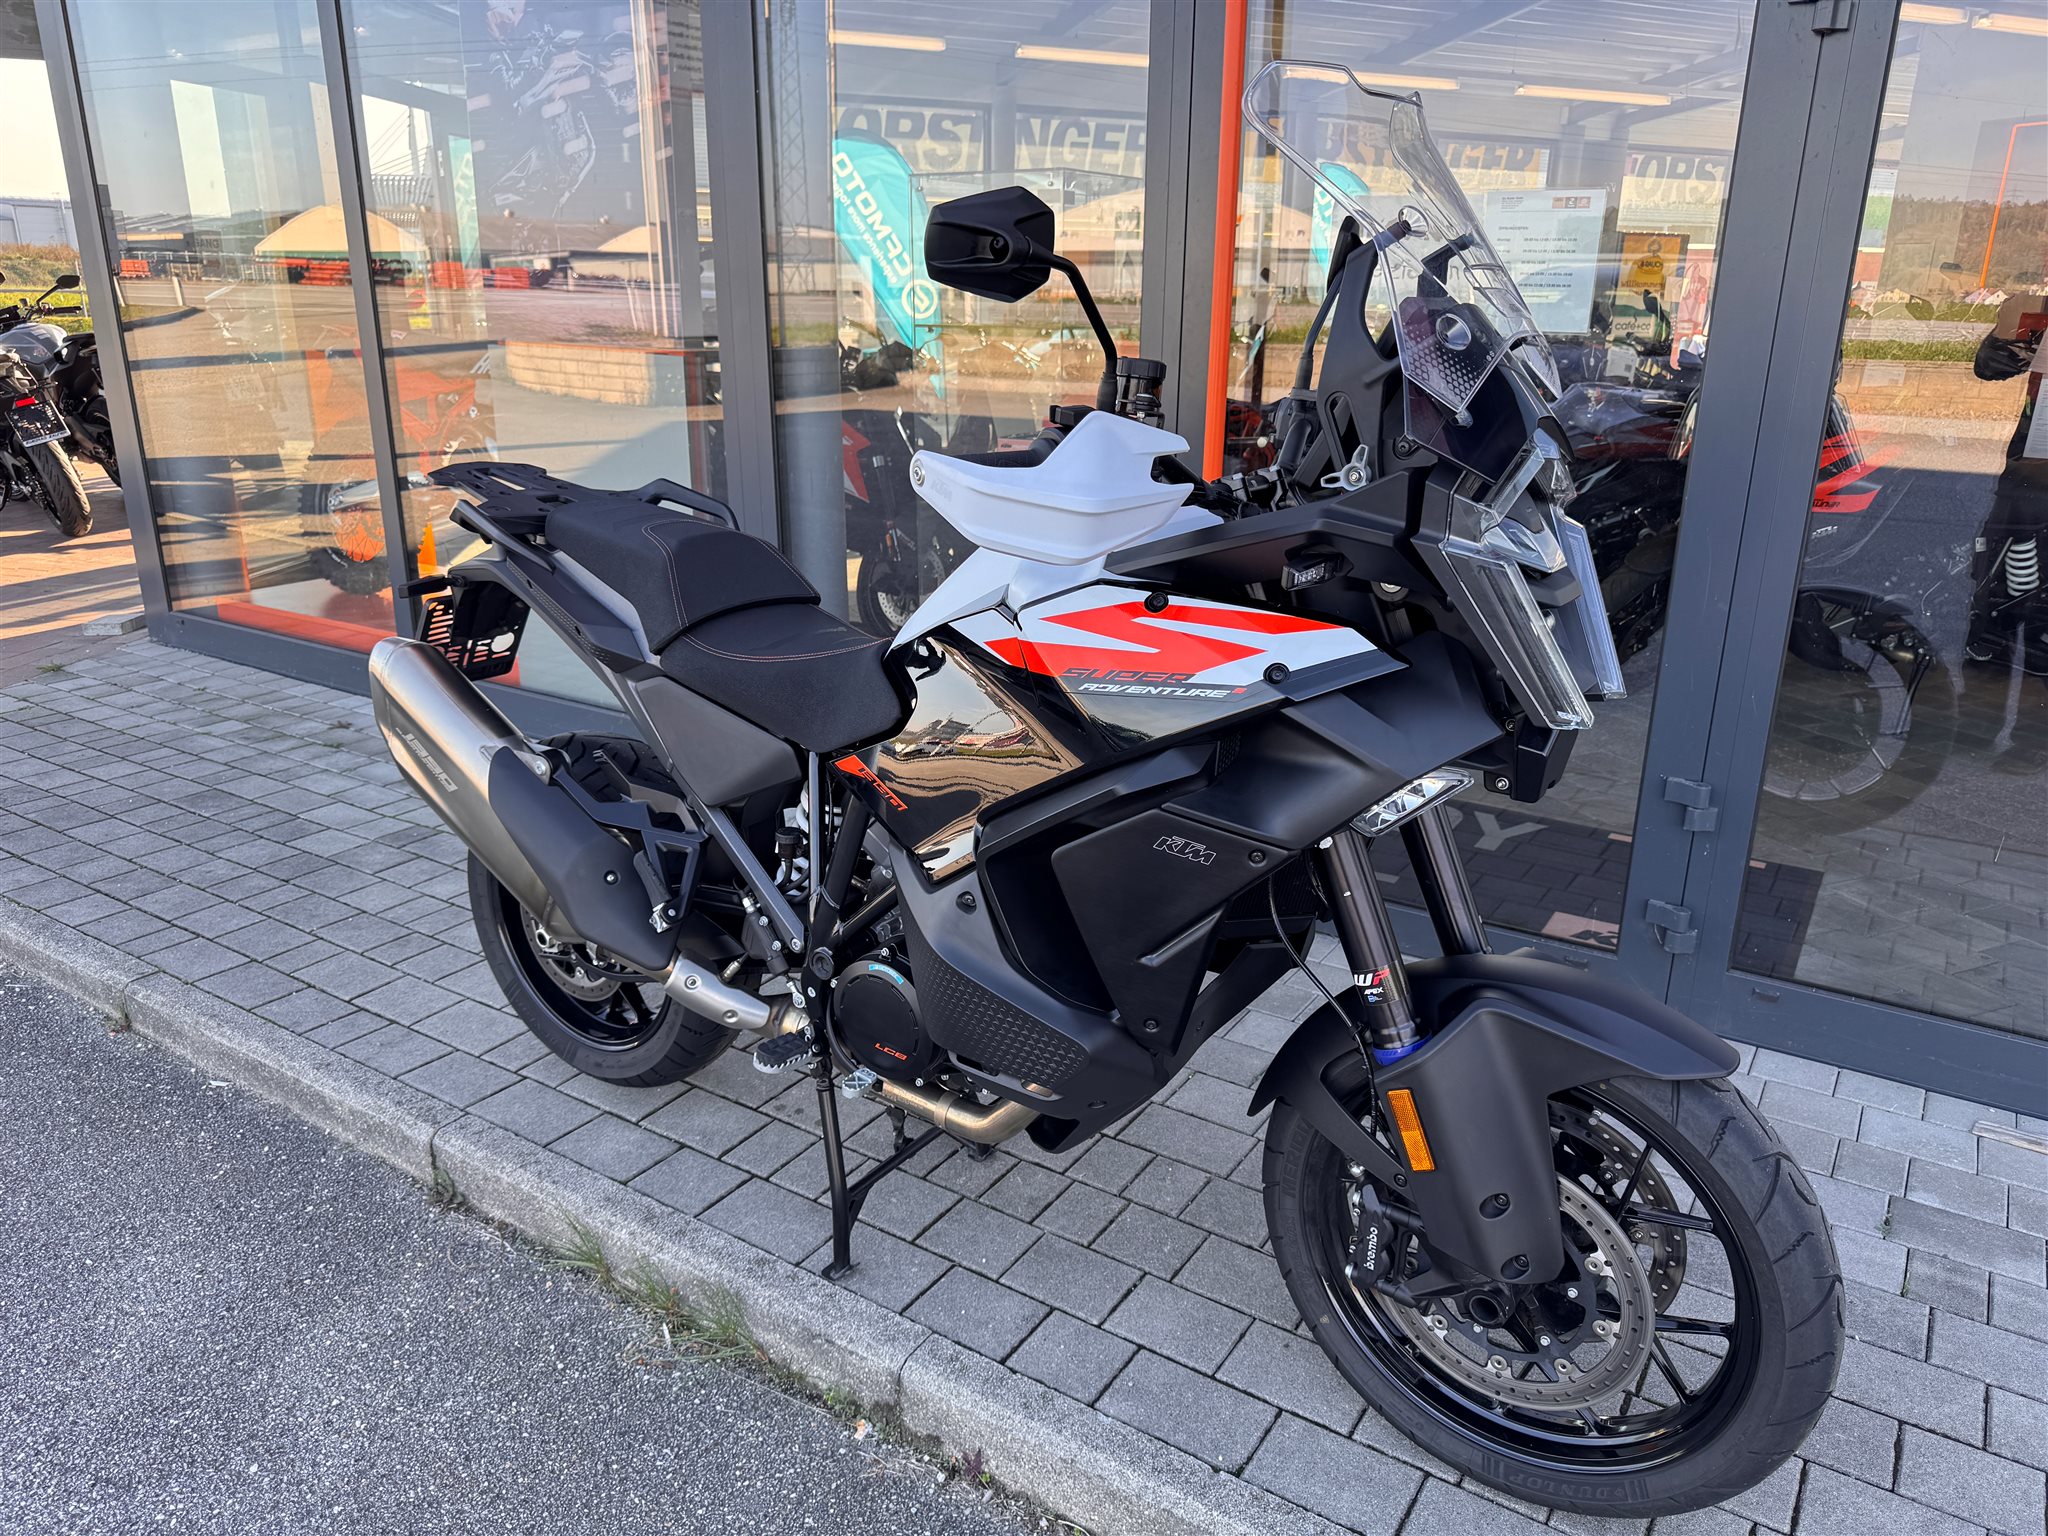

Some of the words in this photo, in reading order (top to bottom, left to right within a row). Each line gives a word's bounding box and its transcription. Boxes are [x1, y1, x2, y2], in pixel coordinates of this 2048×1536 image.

[1060, 667, 1198, 684] SUPER
[1078, 682, 1232, 698] ADVENTURE
[1152, 835, 1217, 866] KTM
[1353, 968, 1391, 987] WP
[874, 1043, 908, 1061] LC8
[1363, 1226, 1378, 1271] brembo
